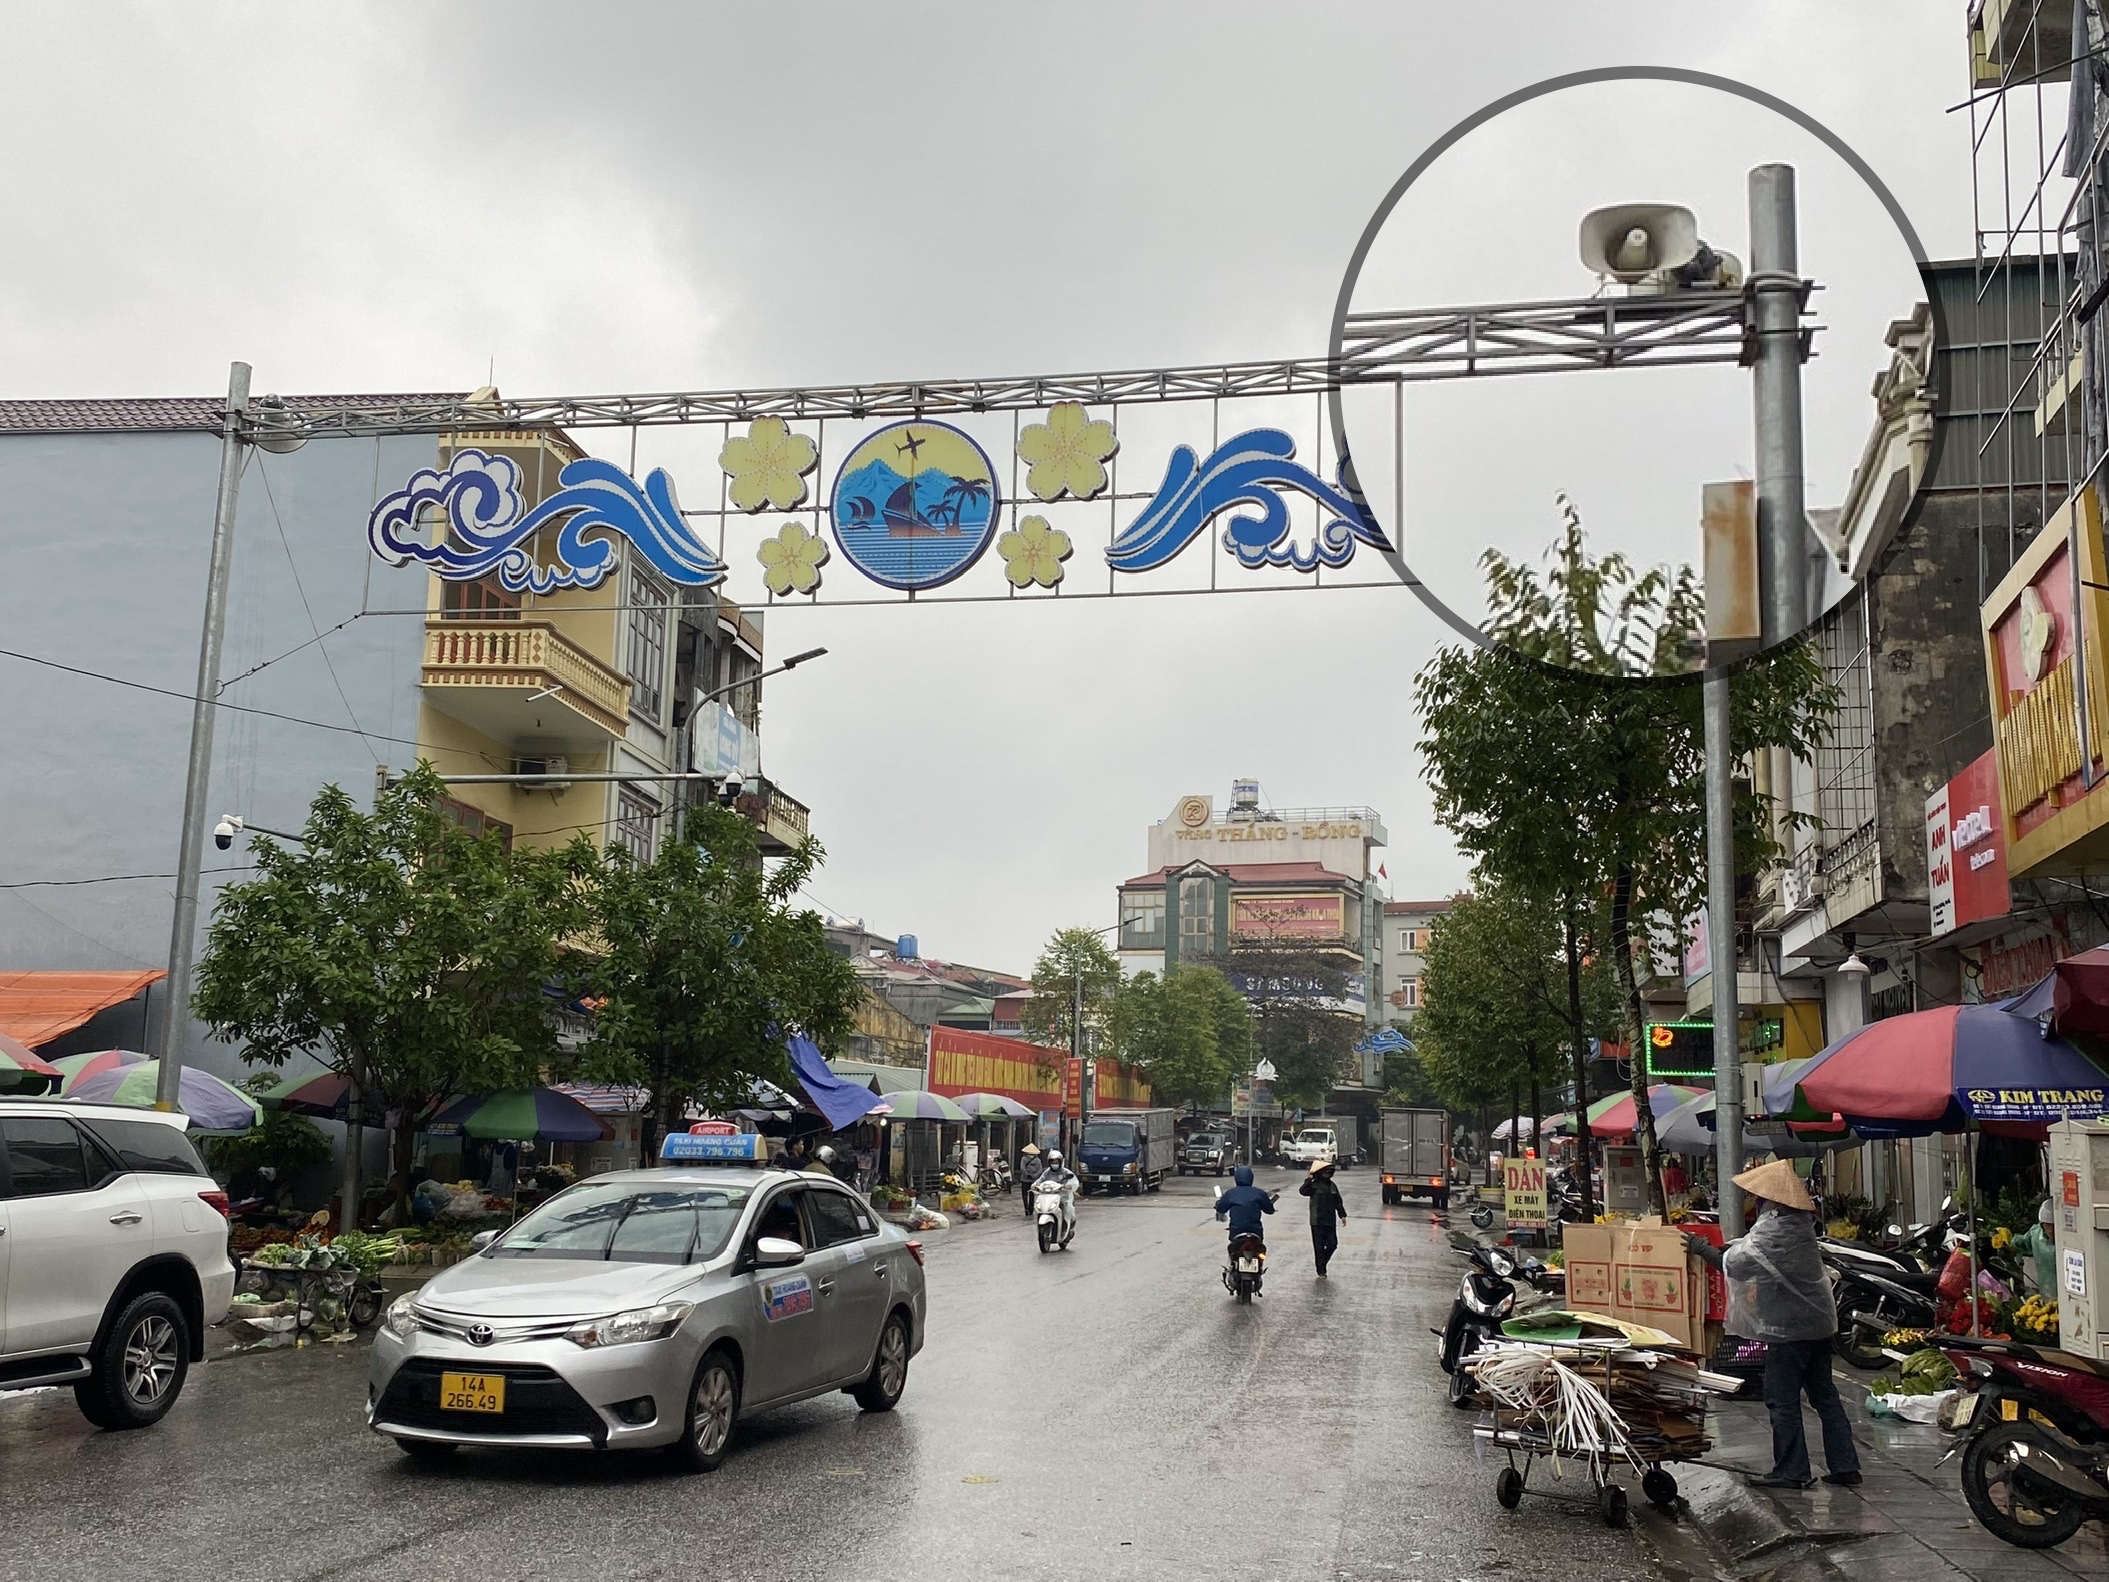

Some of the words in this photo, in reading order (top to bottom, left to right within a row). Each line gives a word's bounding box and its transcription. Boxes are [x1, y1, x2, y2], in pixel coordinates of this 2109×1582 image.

[1931, 824, 1946, 852] ANH
[1999, 1090, 2035, 1104] KIM
[2037, 1089, 2105, 1104] TRANG
[696, 1127, 731, 1135] AIRPORT
[1507, 1160, 1543, 1191] DÁN
[1513, 1195, 1523, 1205] XE
[2016, 1361, 2068, 1377] VISION
[461, 1376, 486, 1392] 14A
[447, 1392, 496, 1410] 266.49
